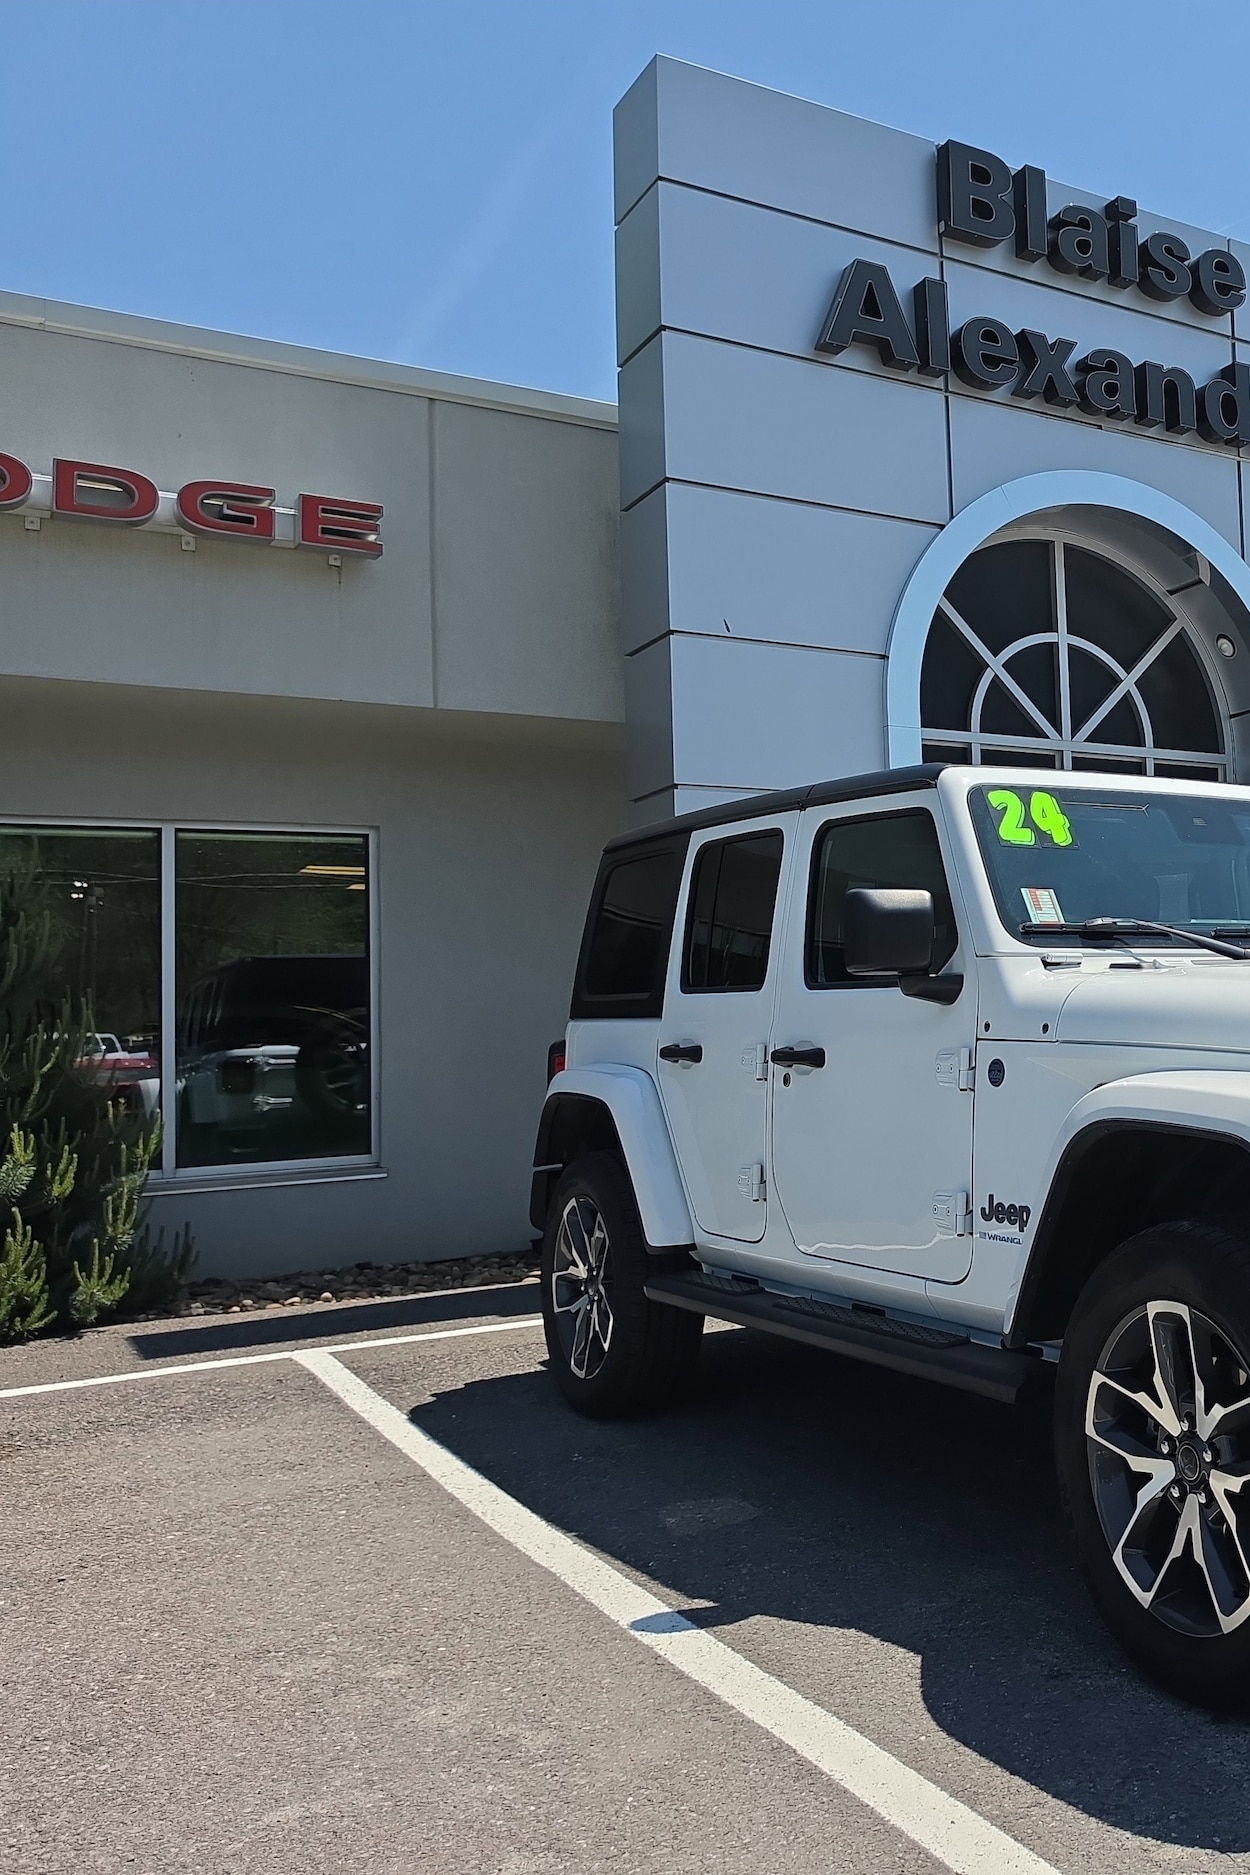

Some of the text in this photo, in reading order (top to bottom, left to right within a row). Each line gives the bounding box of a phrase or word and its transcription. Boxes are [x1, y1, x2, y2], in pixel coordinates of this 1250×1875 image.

[936, 139, 1247, 317] Blaise
[987, 789, 1073, 847] 24
[980, 1193, 1031, 1233] Jeep
